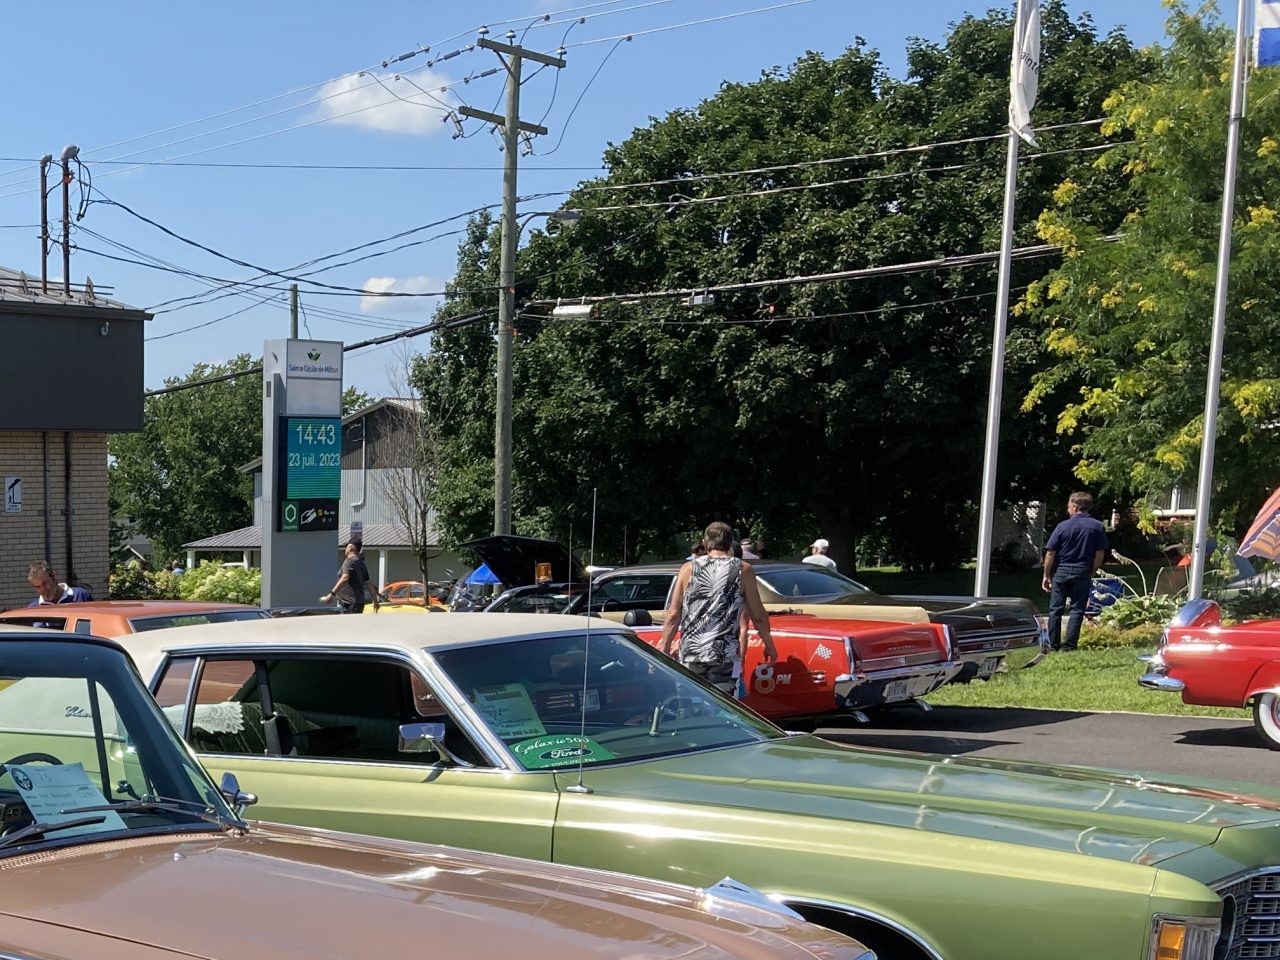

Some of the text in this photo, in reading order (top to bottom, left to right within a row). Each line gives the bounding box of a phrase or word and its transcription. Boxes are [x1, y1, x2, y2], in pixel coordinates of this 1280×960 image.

[296, 424, 336, 445] 14:43
[288, 452, 340, 470] 23 juil. 2023
[754, 663, 792, 694] 8 PM
[550, 748, 582, 759] Ford
